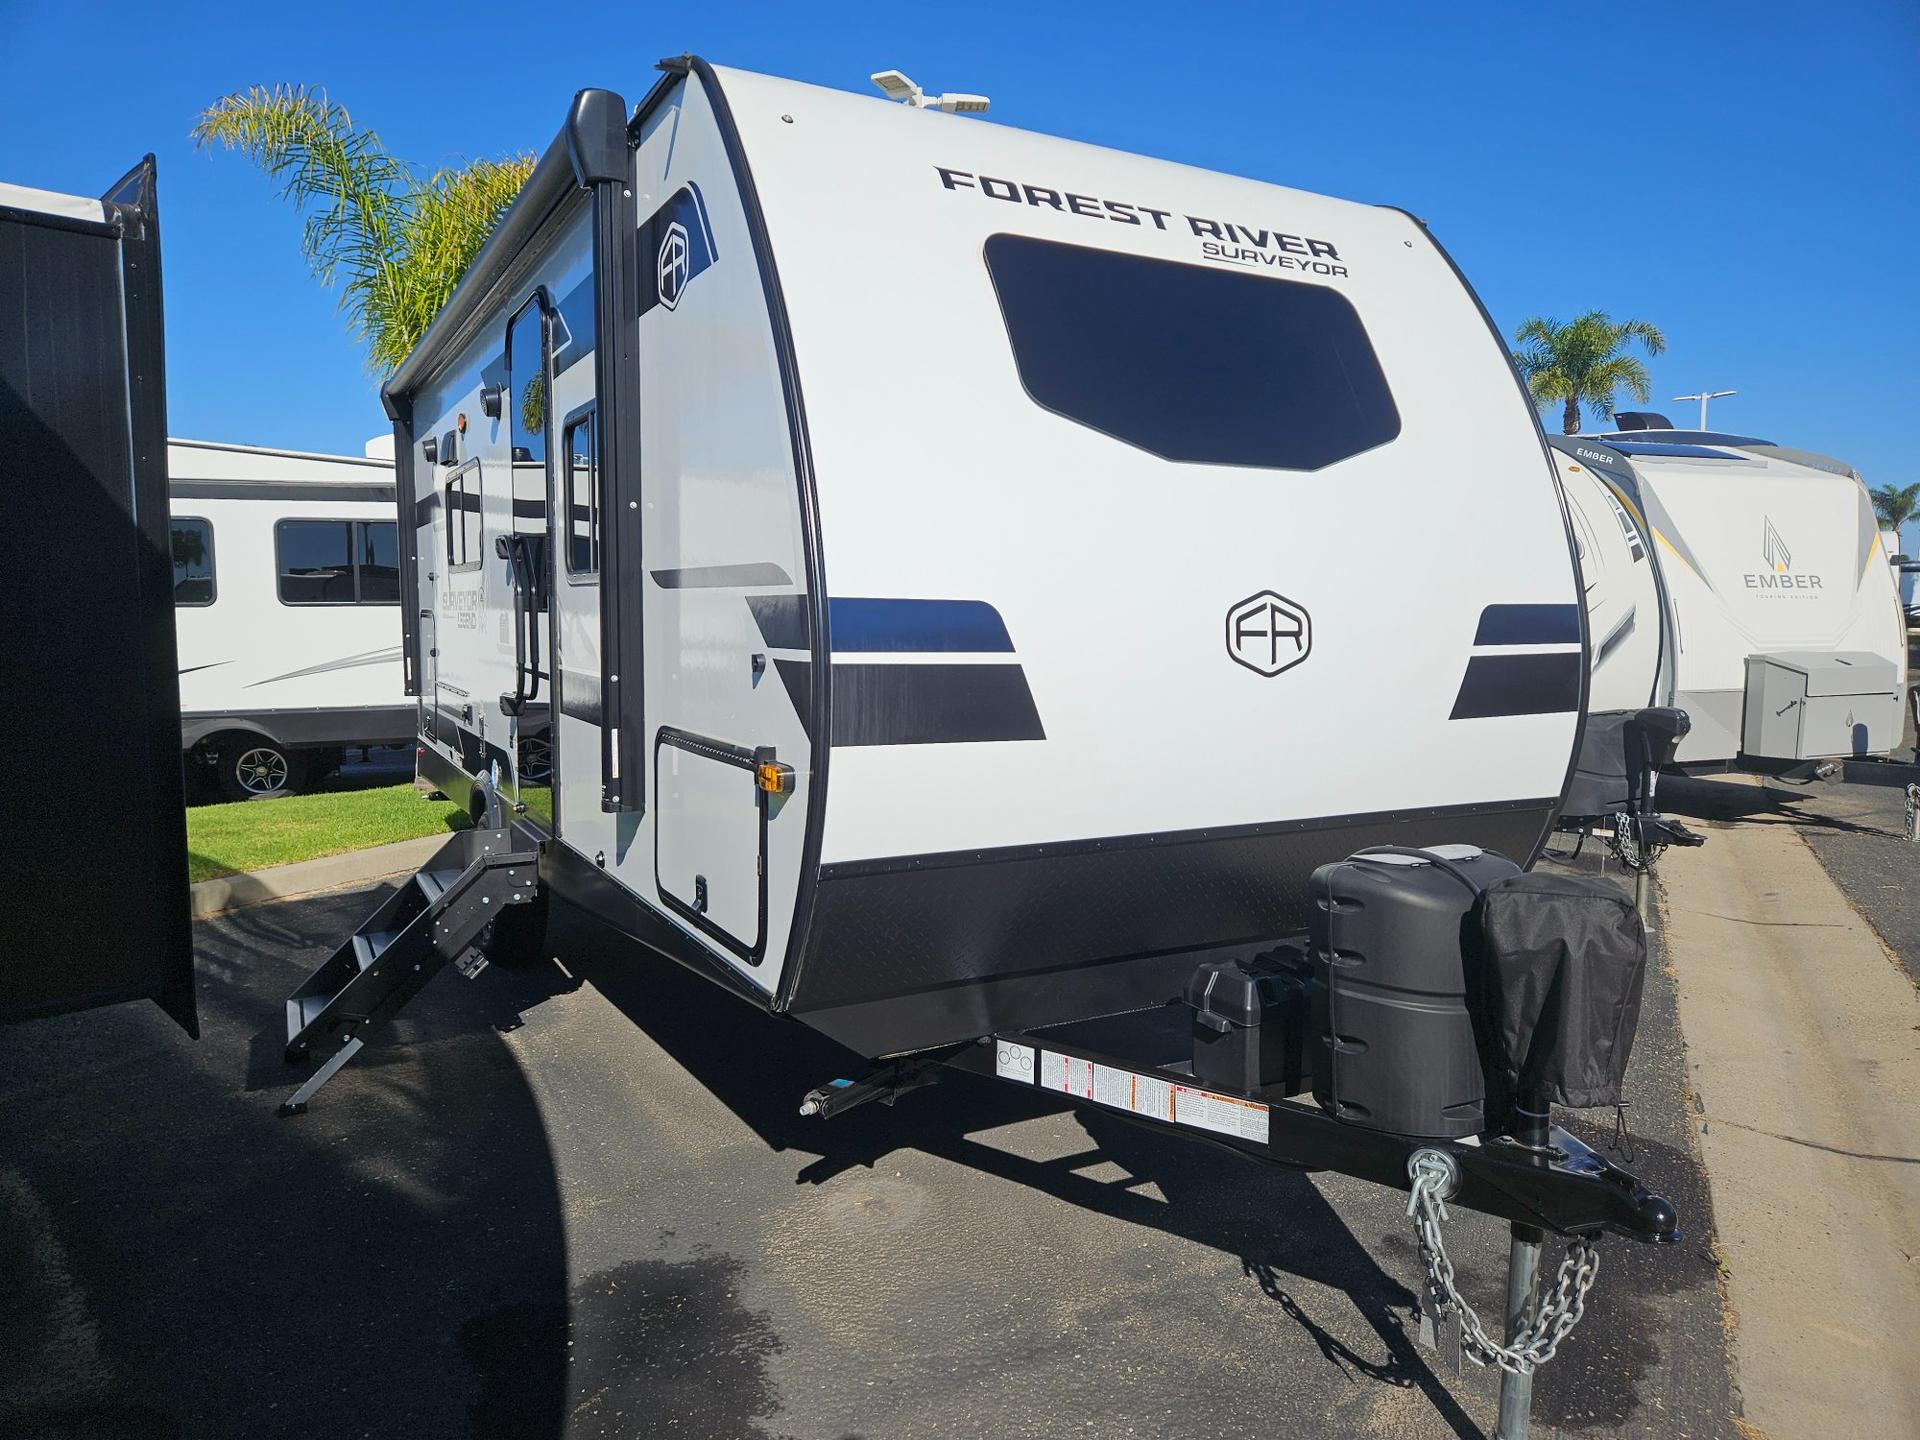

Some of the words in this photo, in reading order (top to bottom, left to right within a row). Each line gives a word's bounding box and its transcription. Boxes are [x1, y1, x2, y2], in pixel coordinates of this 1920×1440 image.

[933, 166, 1171, 230] FOREST
[1184, 214, 1343, 262] RIVER
[1203, 241, 1349, 279] SURVEYOR
[1576, 447, 1614, 465] EMBER
[1743, 574, 1823, 589] EMBER
